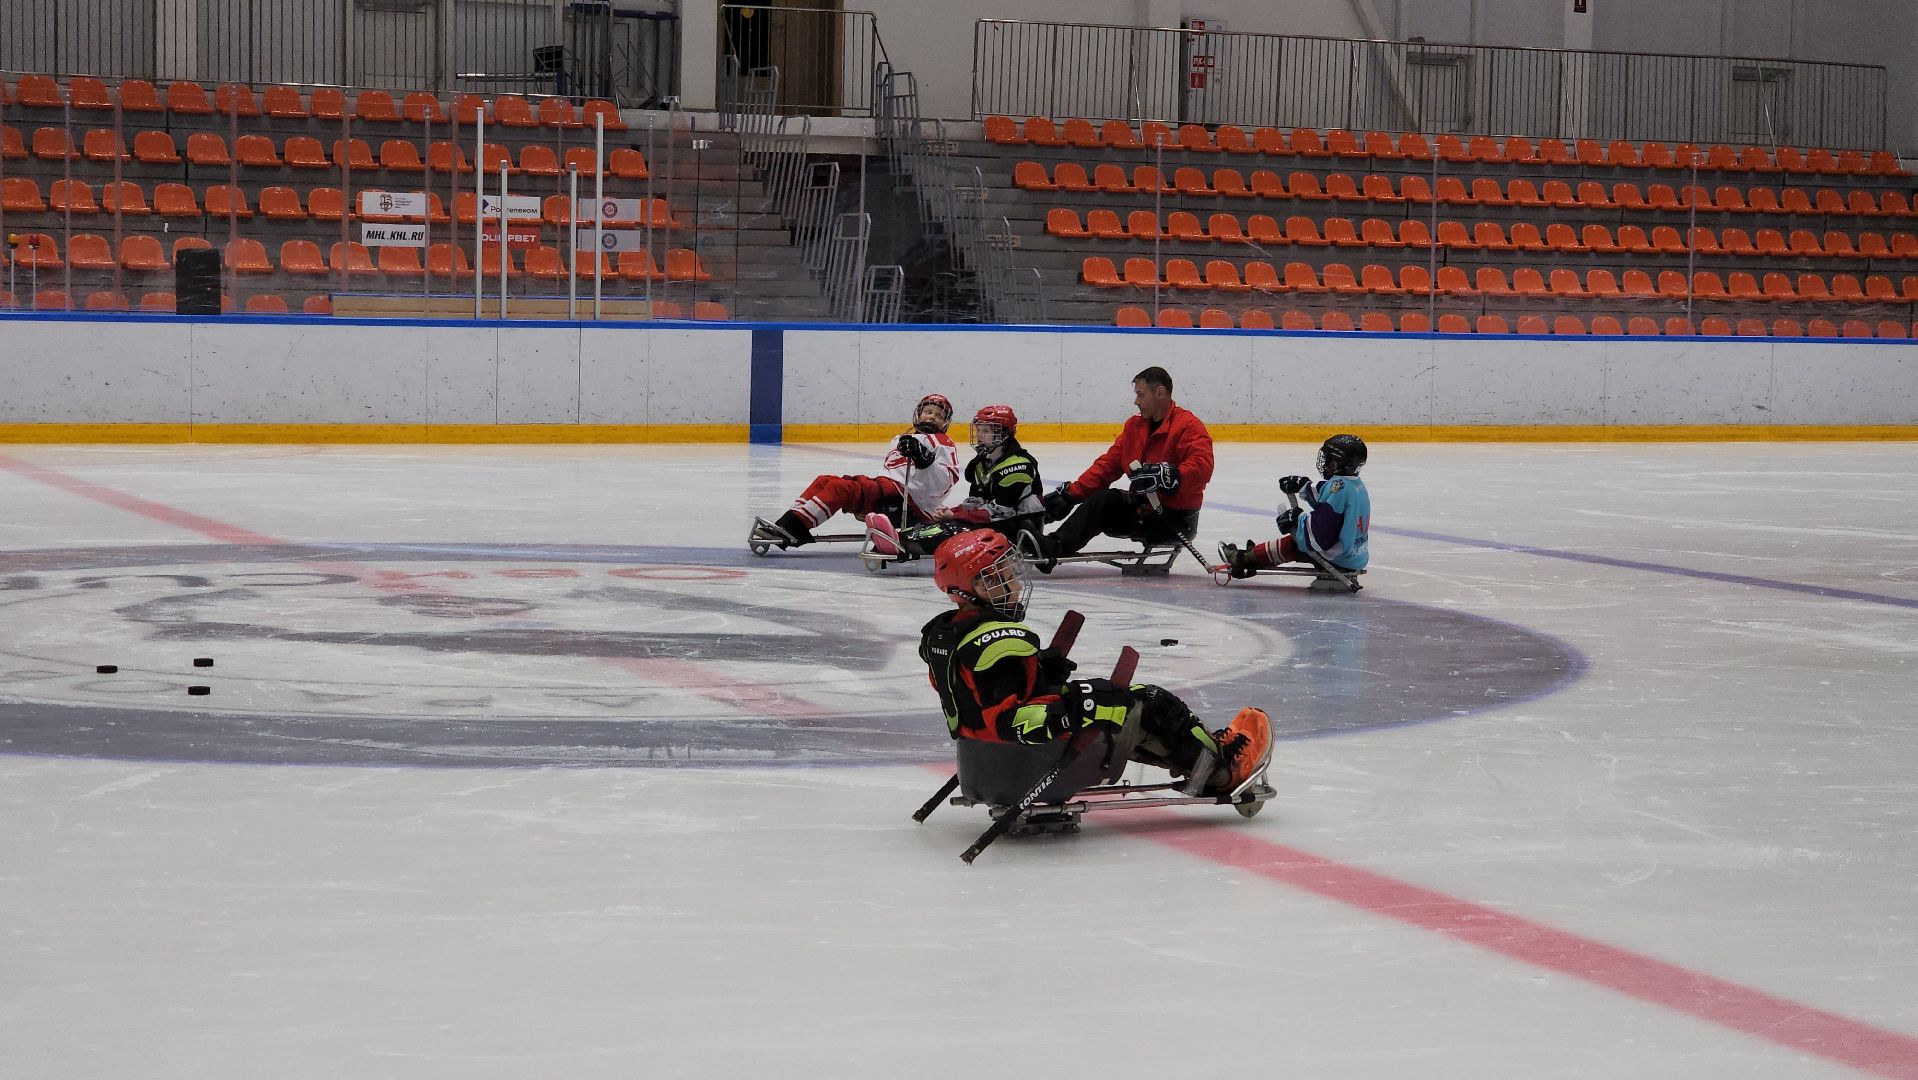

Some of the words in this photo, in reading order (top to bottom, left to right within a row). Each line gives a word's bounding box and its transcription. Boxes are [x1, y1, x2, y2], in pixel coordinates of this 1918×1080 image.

[490, 206, 538, 214] Ротелеком
[366, 230, 424, 241] MHL.KHL.RU
[482, 233, 537, 243] OLIPBET
[973, 629, 1026, 647] VGUARD
